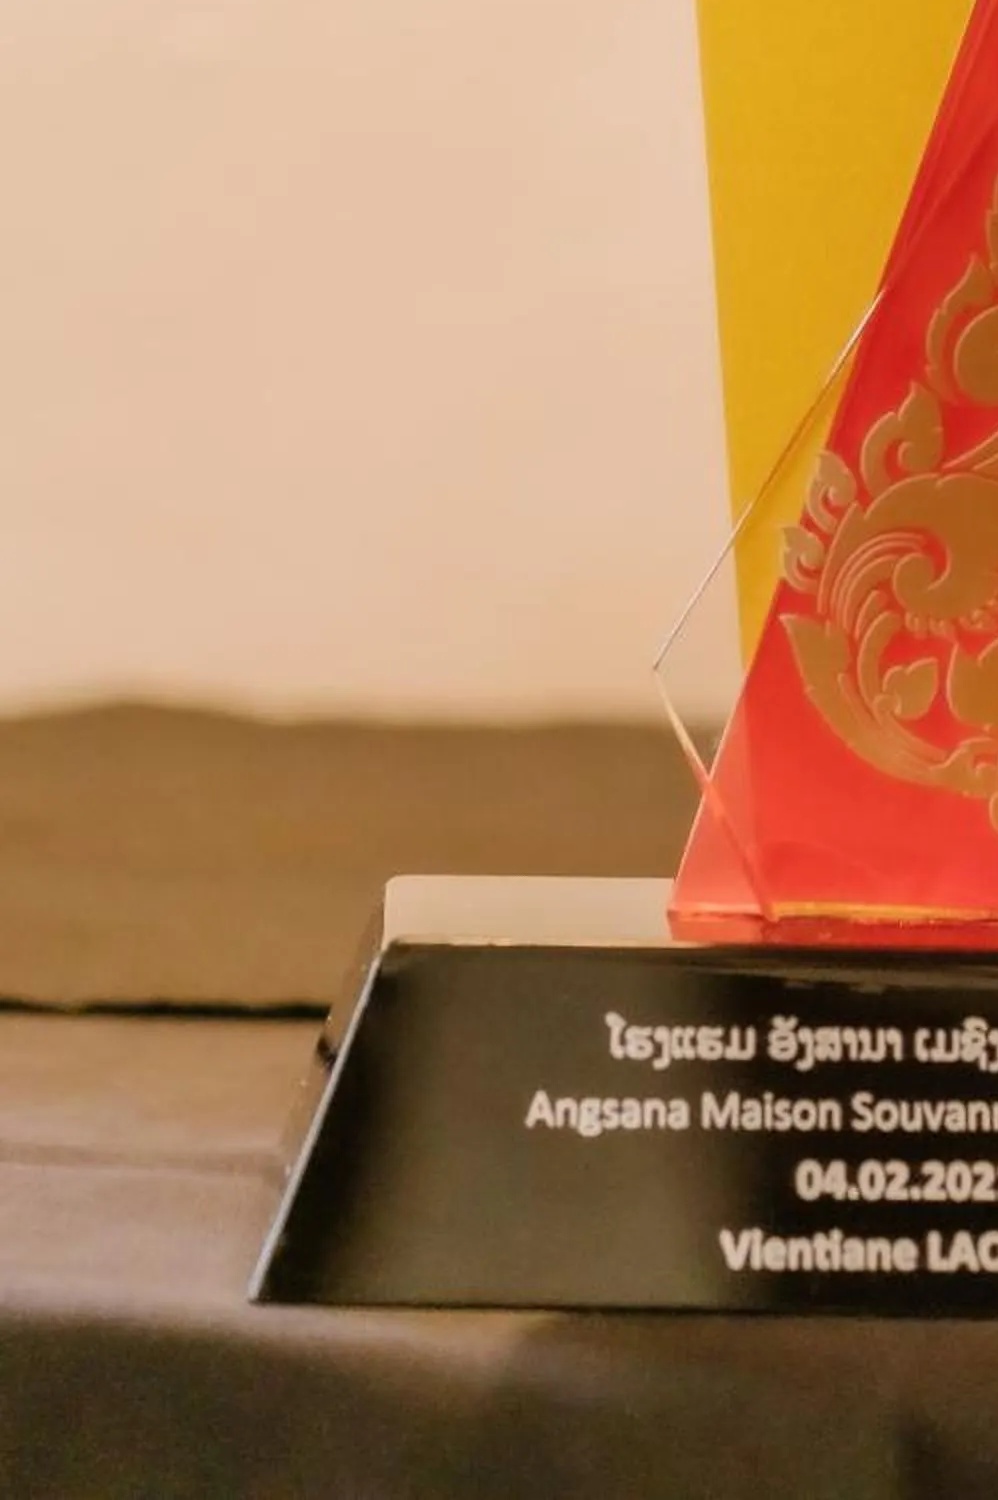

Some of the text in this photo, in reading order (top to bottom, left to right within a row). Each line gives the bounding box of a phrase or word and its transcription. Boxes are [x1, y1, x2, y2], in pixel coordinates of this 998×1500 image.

[525, 1090, 689, 1138] Angsana
[701, 1091, 842, 1131] Maison
[719, 1228, 917, 1273] Vientiane
